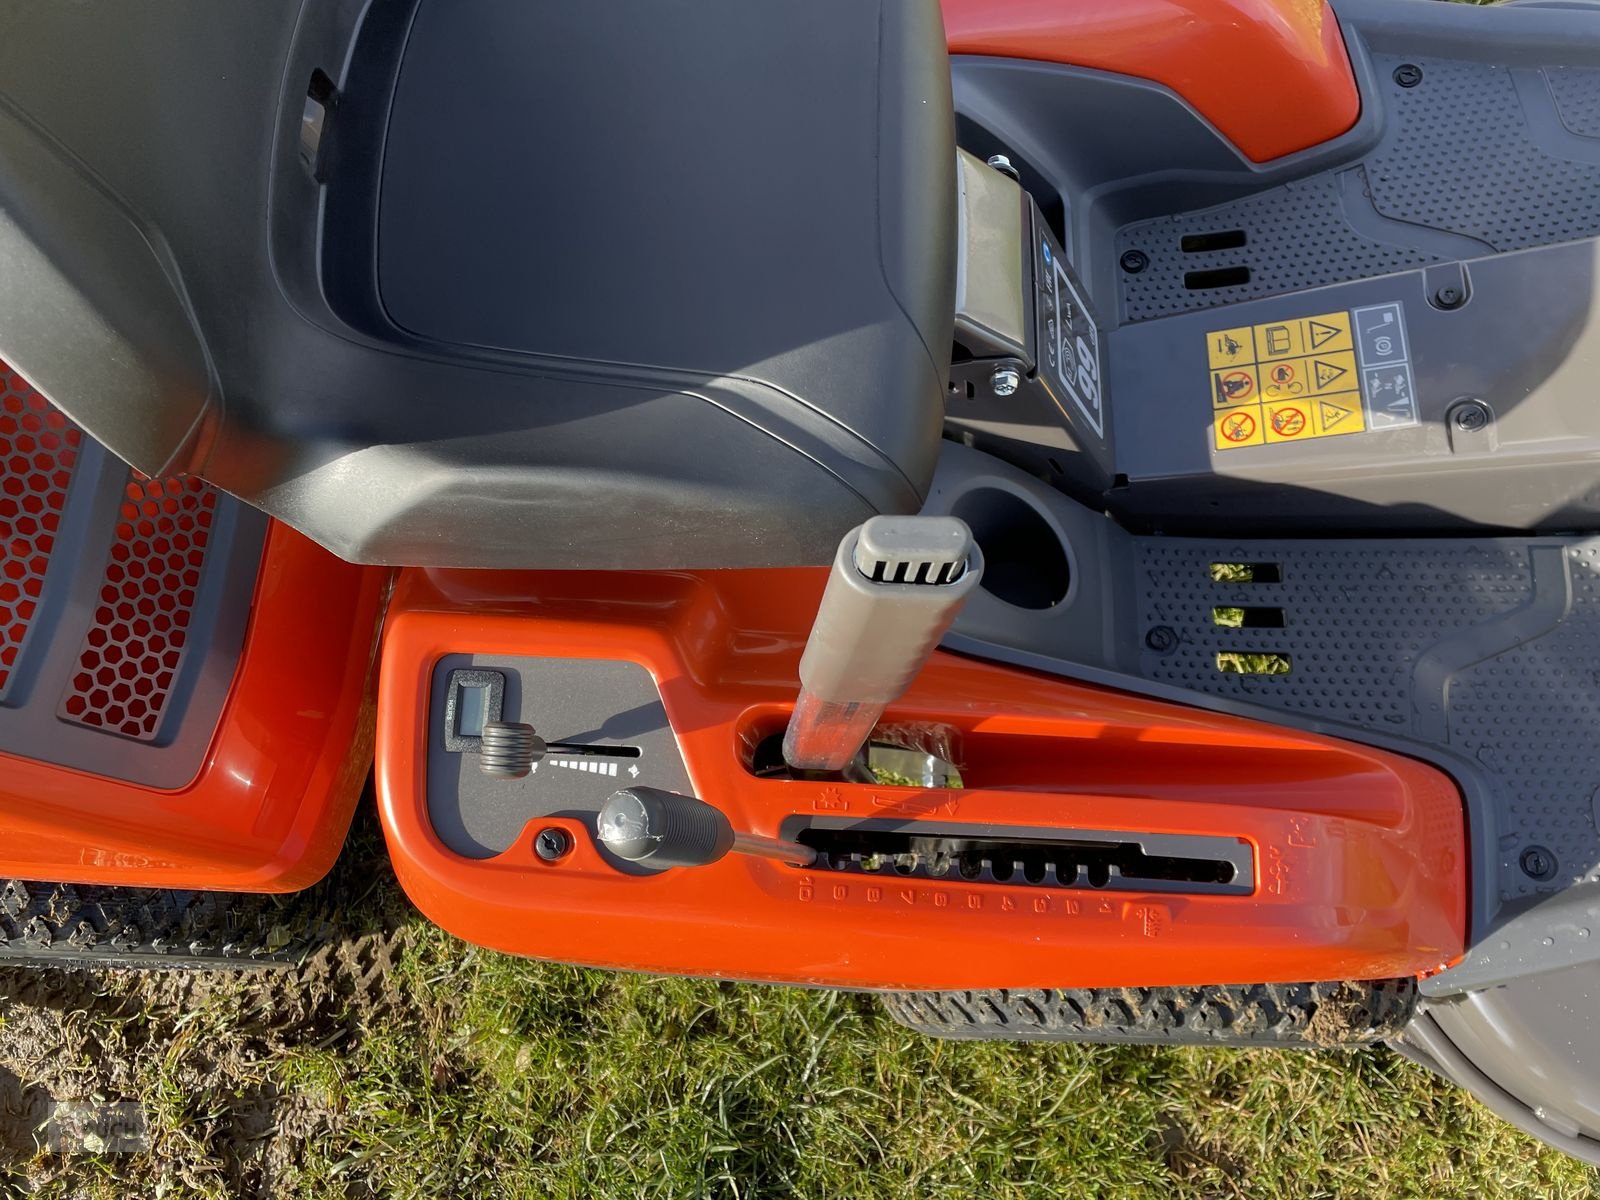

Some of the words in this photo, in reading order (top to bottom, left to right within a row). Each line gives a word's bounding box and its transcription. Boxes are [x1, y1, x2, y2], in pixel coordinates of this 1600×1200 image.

[1076, 336, 1099, 410] 99
[799, 876, 813, 901] 10
[833, 885, 847, 900] 9
[867, 887, 881, 902] 8
[900, 889, 915, 905] 7
[934, 892, 948, 907] 6
[968, 894, 981, 909] 5
[1001, 895, 1015, 911] 4
[1034, 898, 1046, 912] 3
[1066, 899, 1079, 914] 2
[1099, 897, 1112, 912] 1
